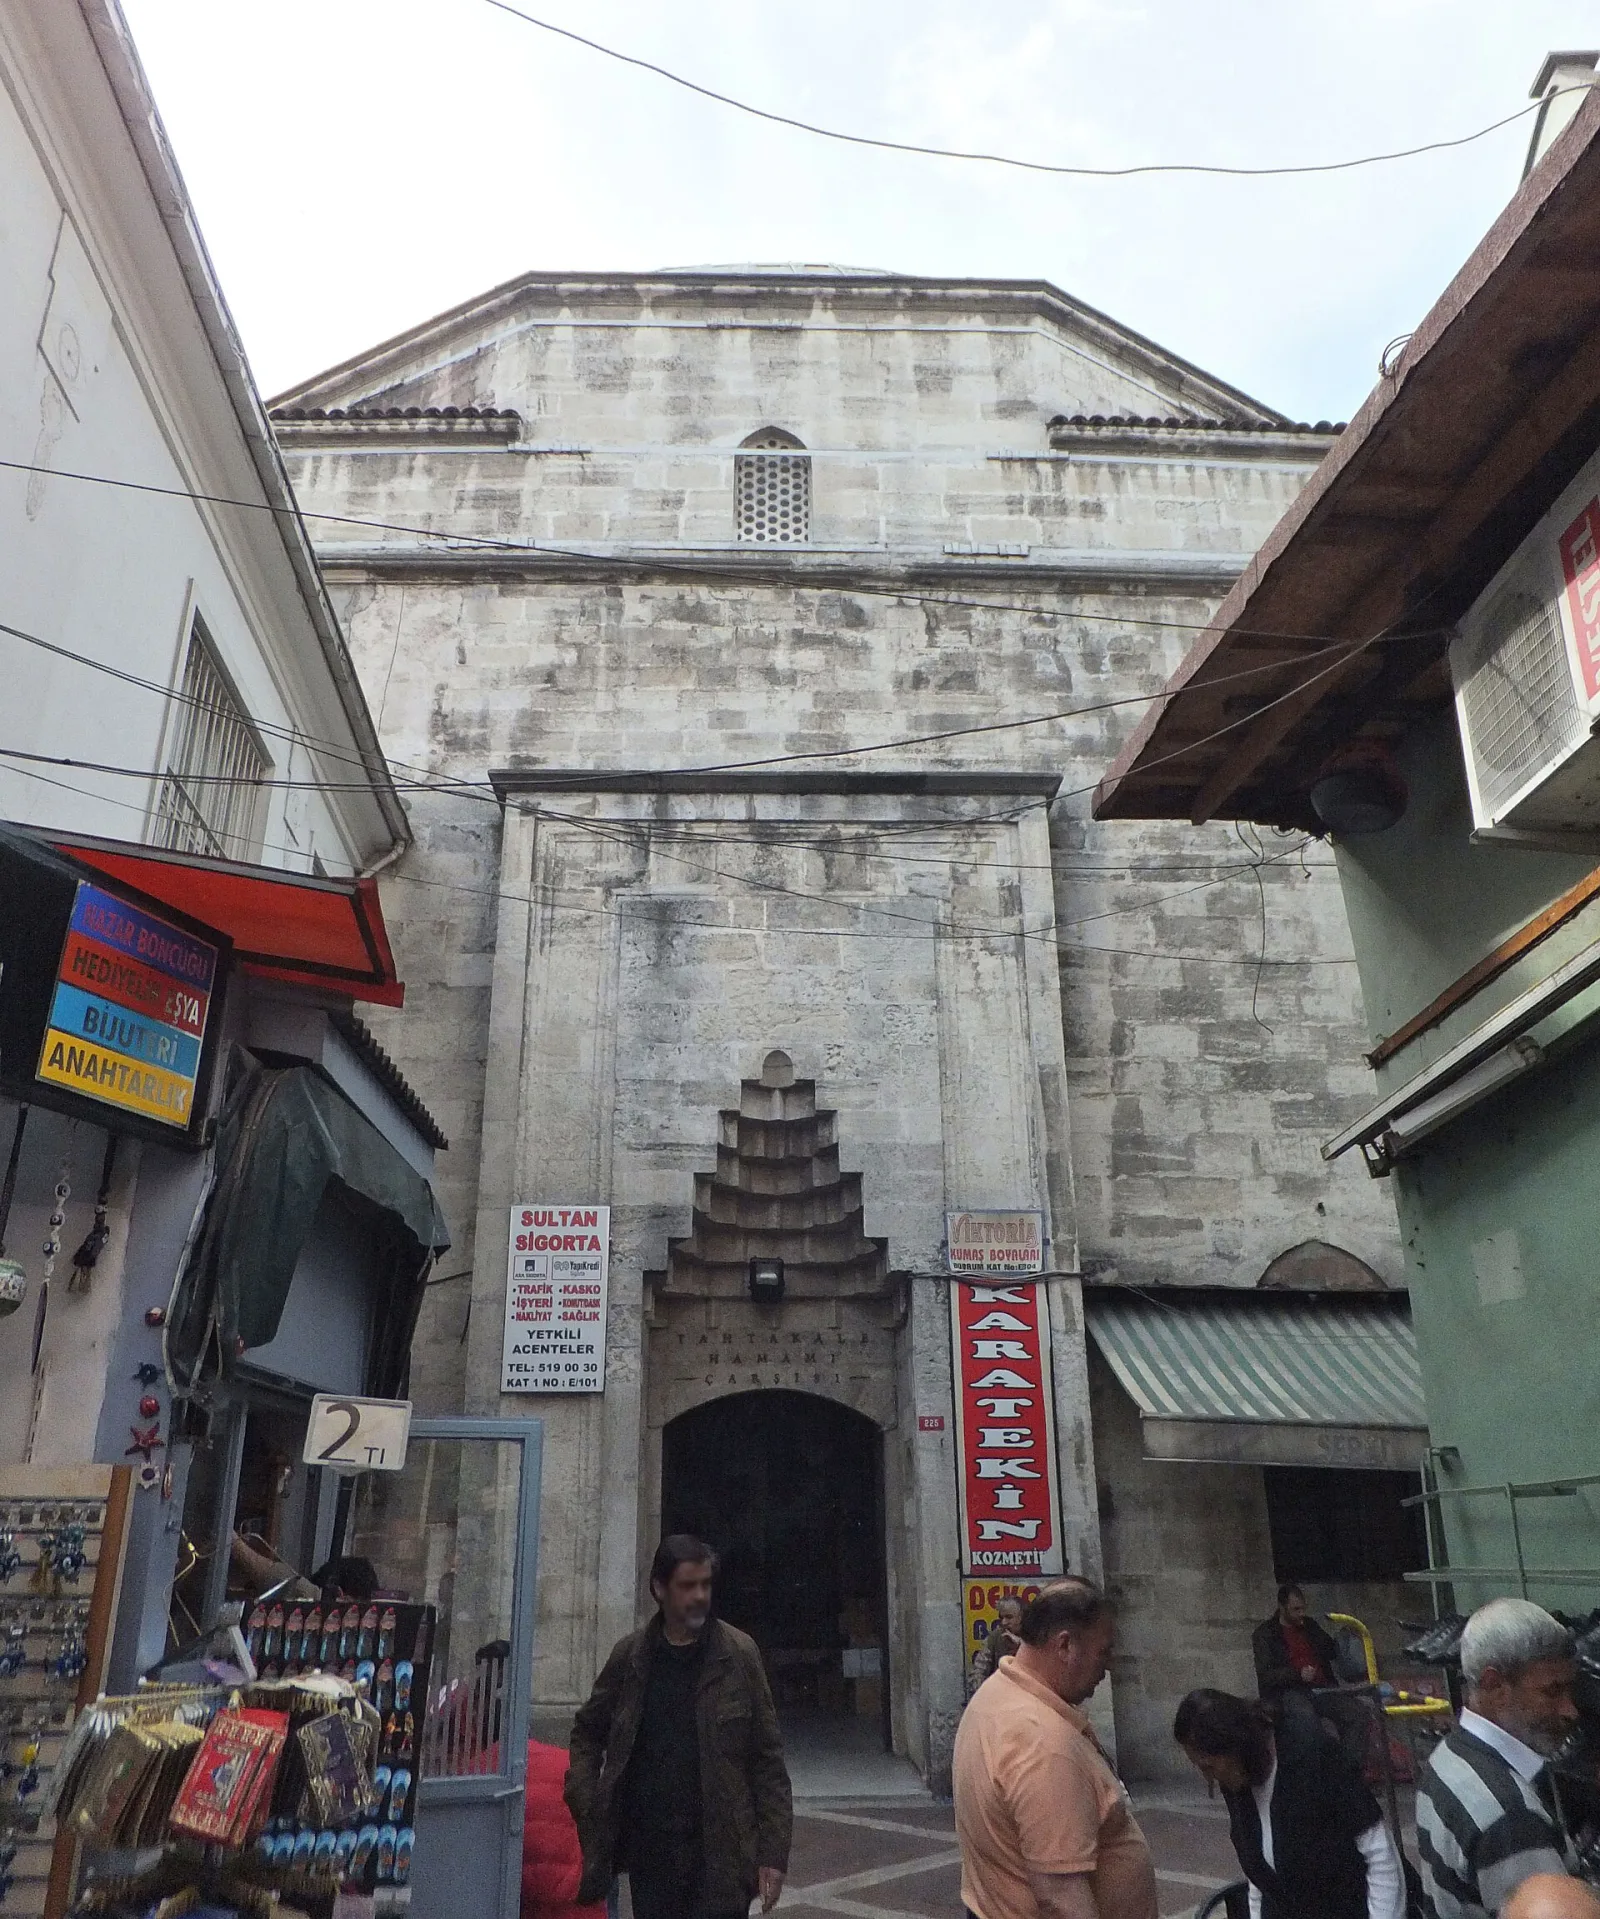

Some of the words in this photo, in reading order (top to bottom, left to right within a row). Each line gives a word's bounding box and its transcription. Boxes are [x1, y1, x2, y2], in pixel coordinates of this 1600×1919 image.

[82, 903, 136, 946] NAZAR
[163, 990, 199, 1026] EŞYA
[83, 1004, 178, 1064] BİJUTERİ
[48, 1041, 187, 1111] ANAHTARLIK
[521, 1211, 598, 1227] SULTAN
[515, 1231, 601, 1251] SİGORTA
[950, 1248, 984, 1262] KUMAŞ
[989, 1248, 1040, 1261] BOYALARI
[986, 1263, 1002, 1271] KAT
[517, 1282, 554, 1294] TRAFİK
[563, 1284, 601, 1295] KASKO
[516, 1296, 553, 1310] İŞYERİ
[515, 1310, 553, 1321] NAKLİYAT
[562, 1309, 601, 1321] SAĞLIK
[527, 1328, 581, 1340] YETKİLİ
[677, 1333, 870, 1344] TAHTAKALE
[512, 1344, 595, 1354] ACENTELER
[708, 1353, 836, 1364] HAMAMI
[508, 1363, 535, 1373] TEL:
[538, 1363, 561, 1373] 519
[564, 1363, 580, 1373] 00
[583, 1363, 598, 1373] 30
[506, 1378, 530, 1388] KAT
[533, 1378, 538, 1388] 1
[542, 1378, 559, 1388] NO
[568, 1378, 598, 1388] E/101
[967, 1286, 1043, 1540] KARATEKİN
[924, 1419, 939, 1428] 225
[318, 1402, 361, 1463] 2
